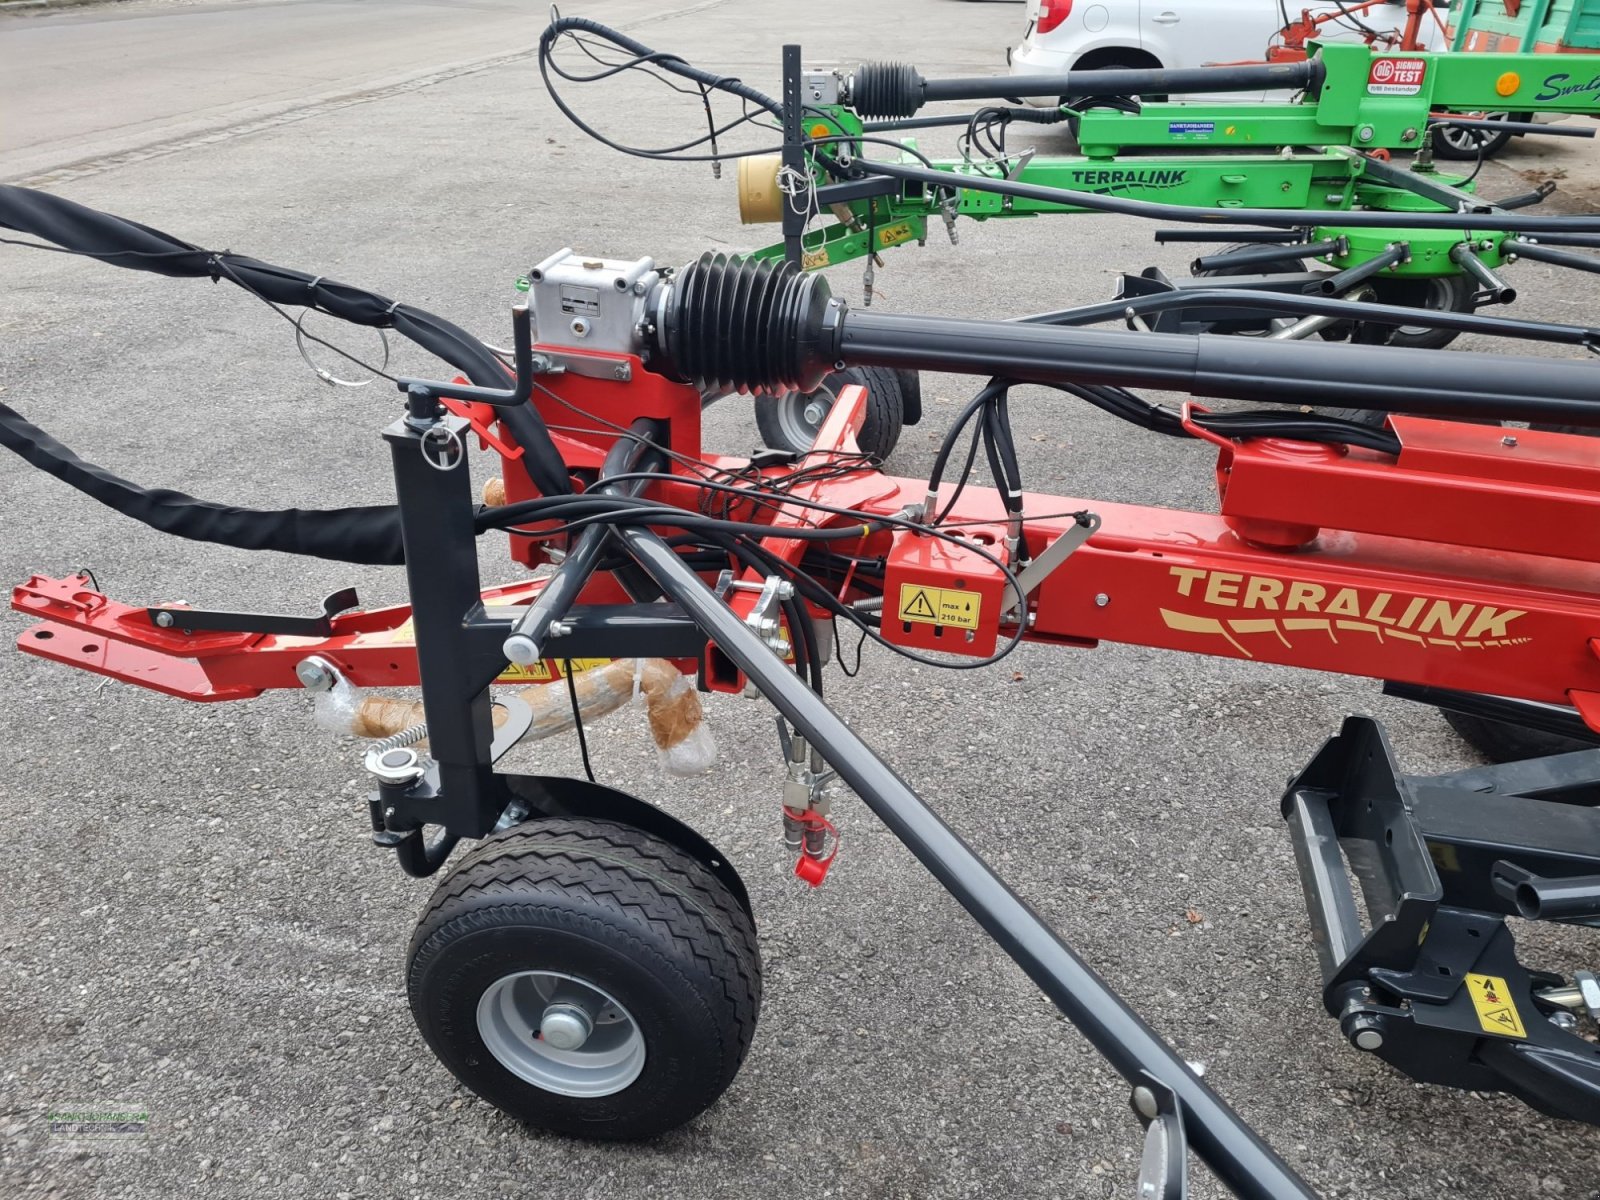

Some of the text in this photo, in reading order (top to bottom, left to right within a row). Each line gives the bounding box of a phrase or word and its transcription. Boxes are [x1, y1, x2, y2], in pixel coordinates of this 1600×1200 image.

[1395, 61, 1424, 70] SIGNUM
[1394, 71, 1421, 82] TEST
[1071, 170, 1188, 185] TERRALINK
[1169, 566, 1528, 638] TERRALINK
[941, 614, 972, 624] 210 bar
